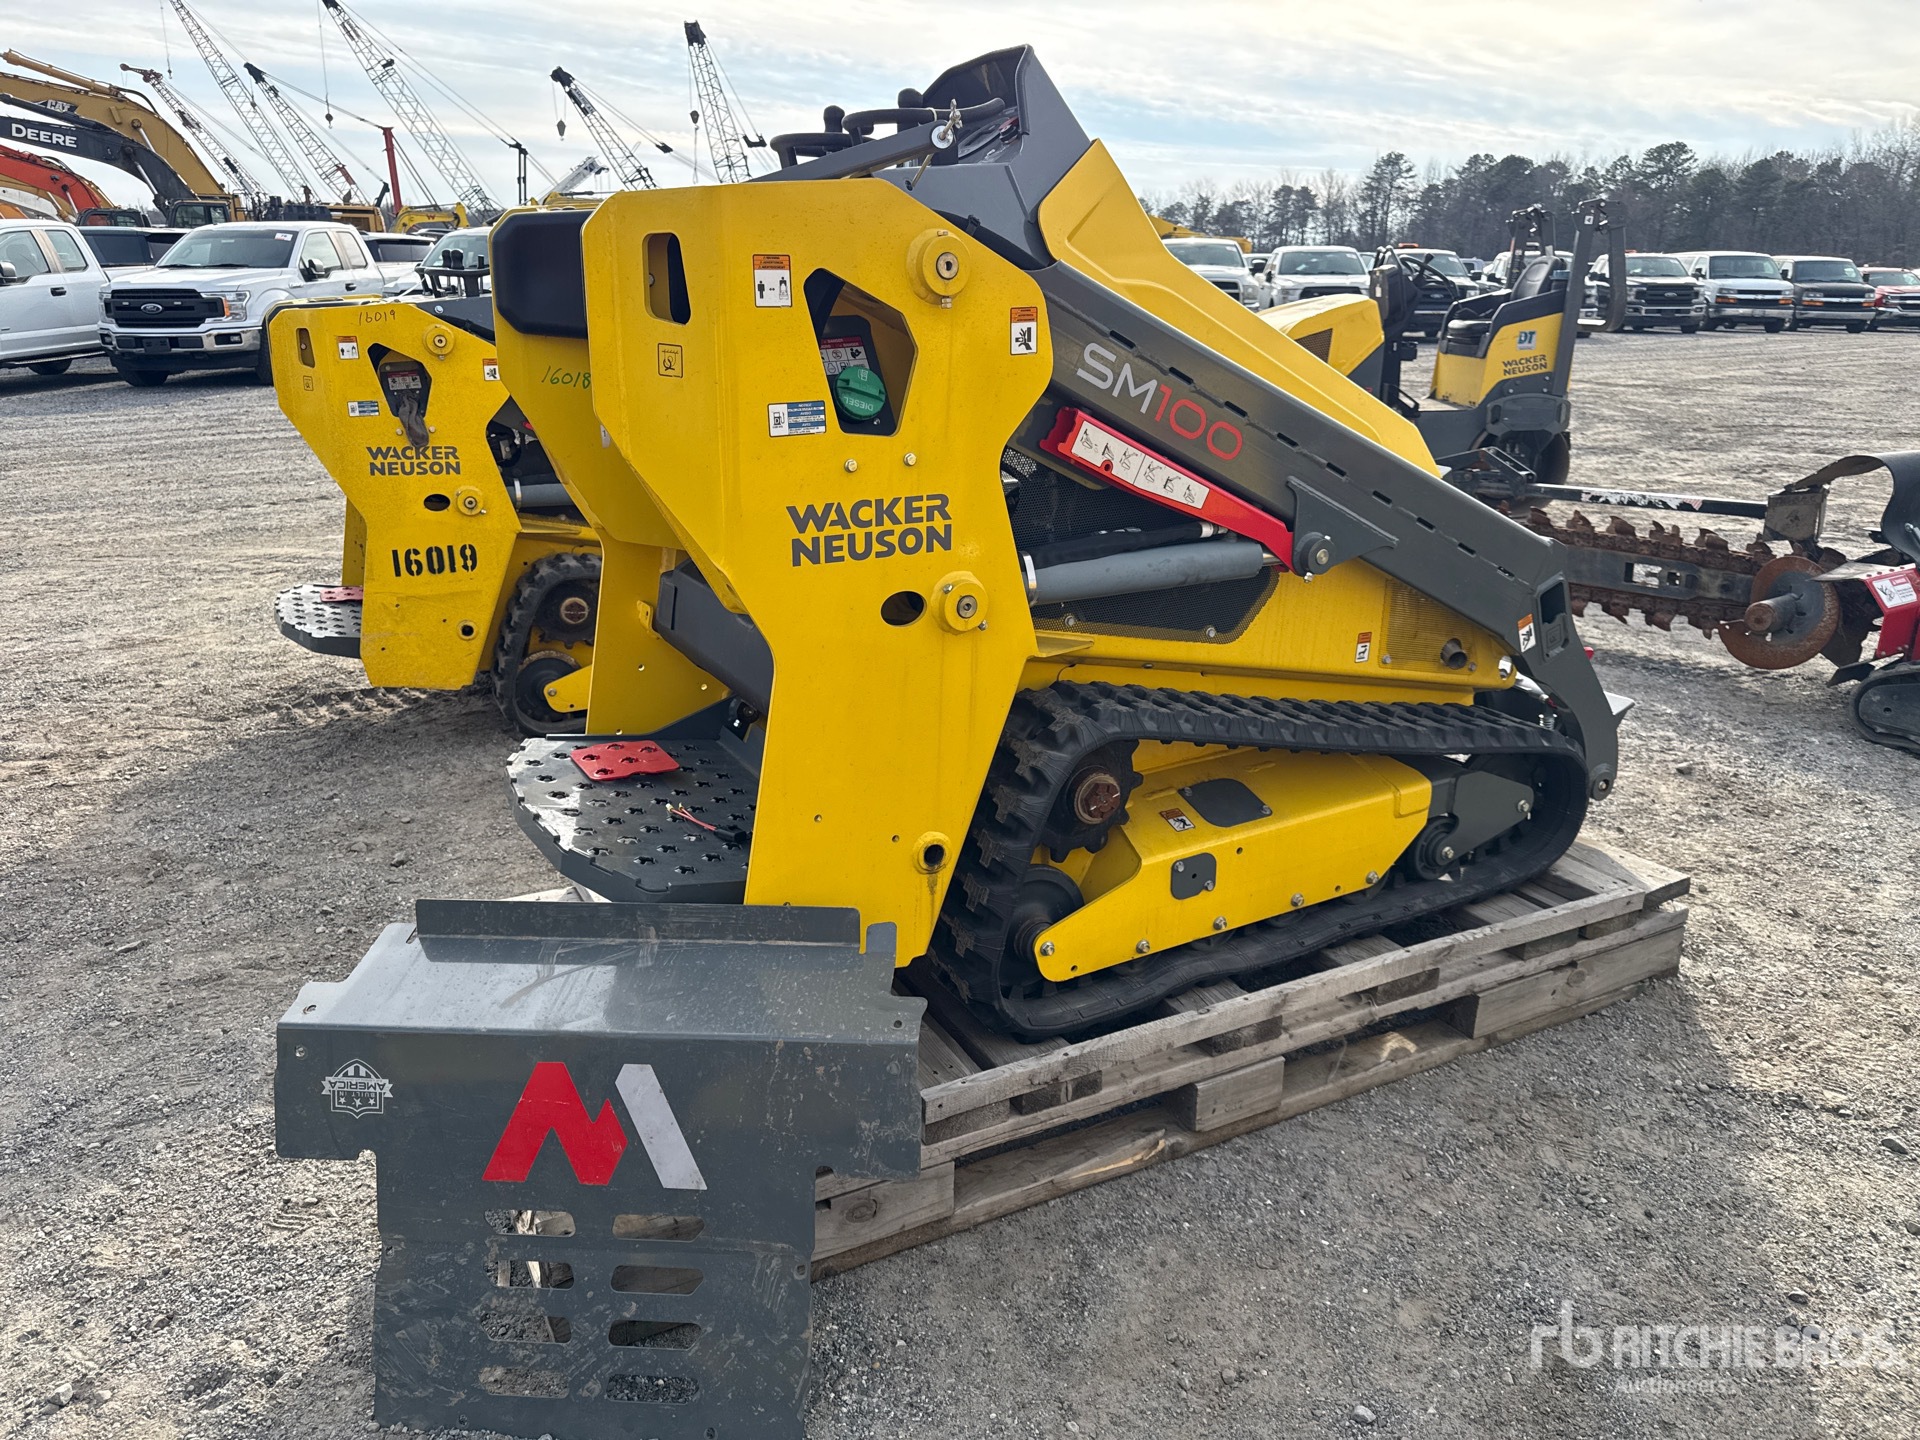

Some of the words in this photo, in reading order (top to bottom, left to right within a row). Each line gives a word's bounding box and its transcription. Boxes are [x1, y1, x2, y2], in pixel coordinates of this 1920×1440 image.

[46, 99, 71, 114] CAT
[11, 123, 77, 148] DEERE
[359, 309, 396, 326] 16019
[1518, 330, 1536, 345] DT
[1502, 354, 1547, 368] WACKER
[1503, 362, 1548, 377] NEUSON
[541, 365, 591, 389] 16018
[844, 395, 874, 412] DIESEL
[1076, 341, 1243, 462] SM100
[366, 446, 460, 460] WACKER
[369, 461, 461, 476] NEUSON
[786, 493, 952, 534] WACKER
[791, 523, 952, 567] NEUSON
[392, 543, 478, 578] 16019
[328, 1080, 387, 1091] AMERICA
